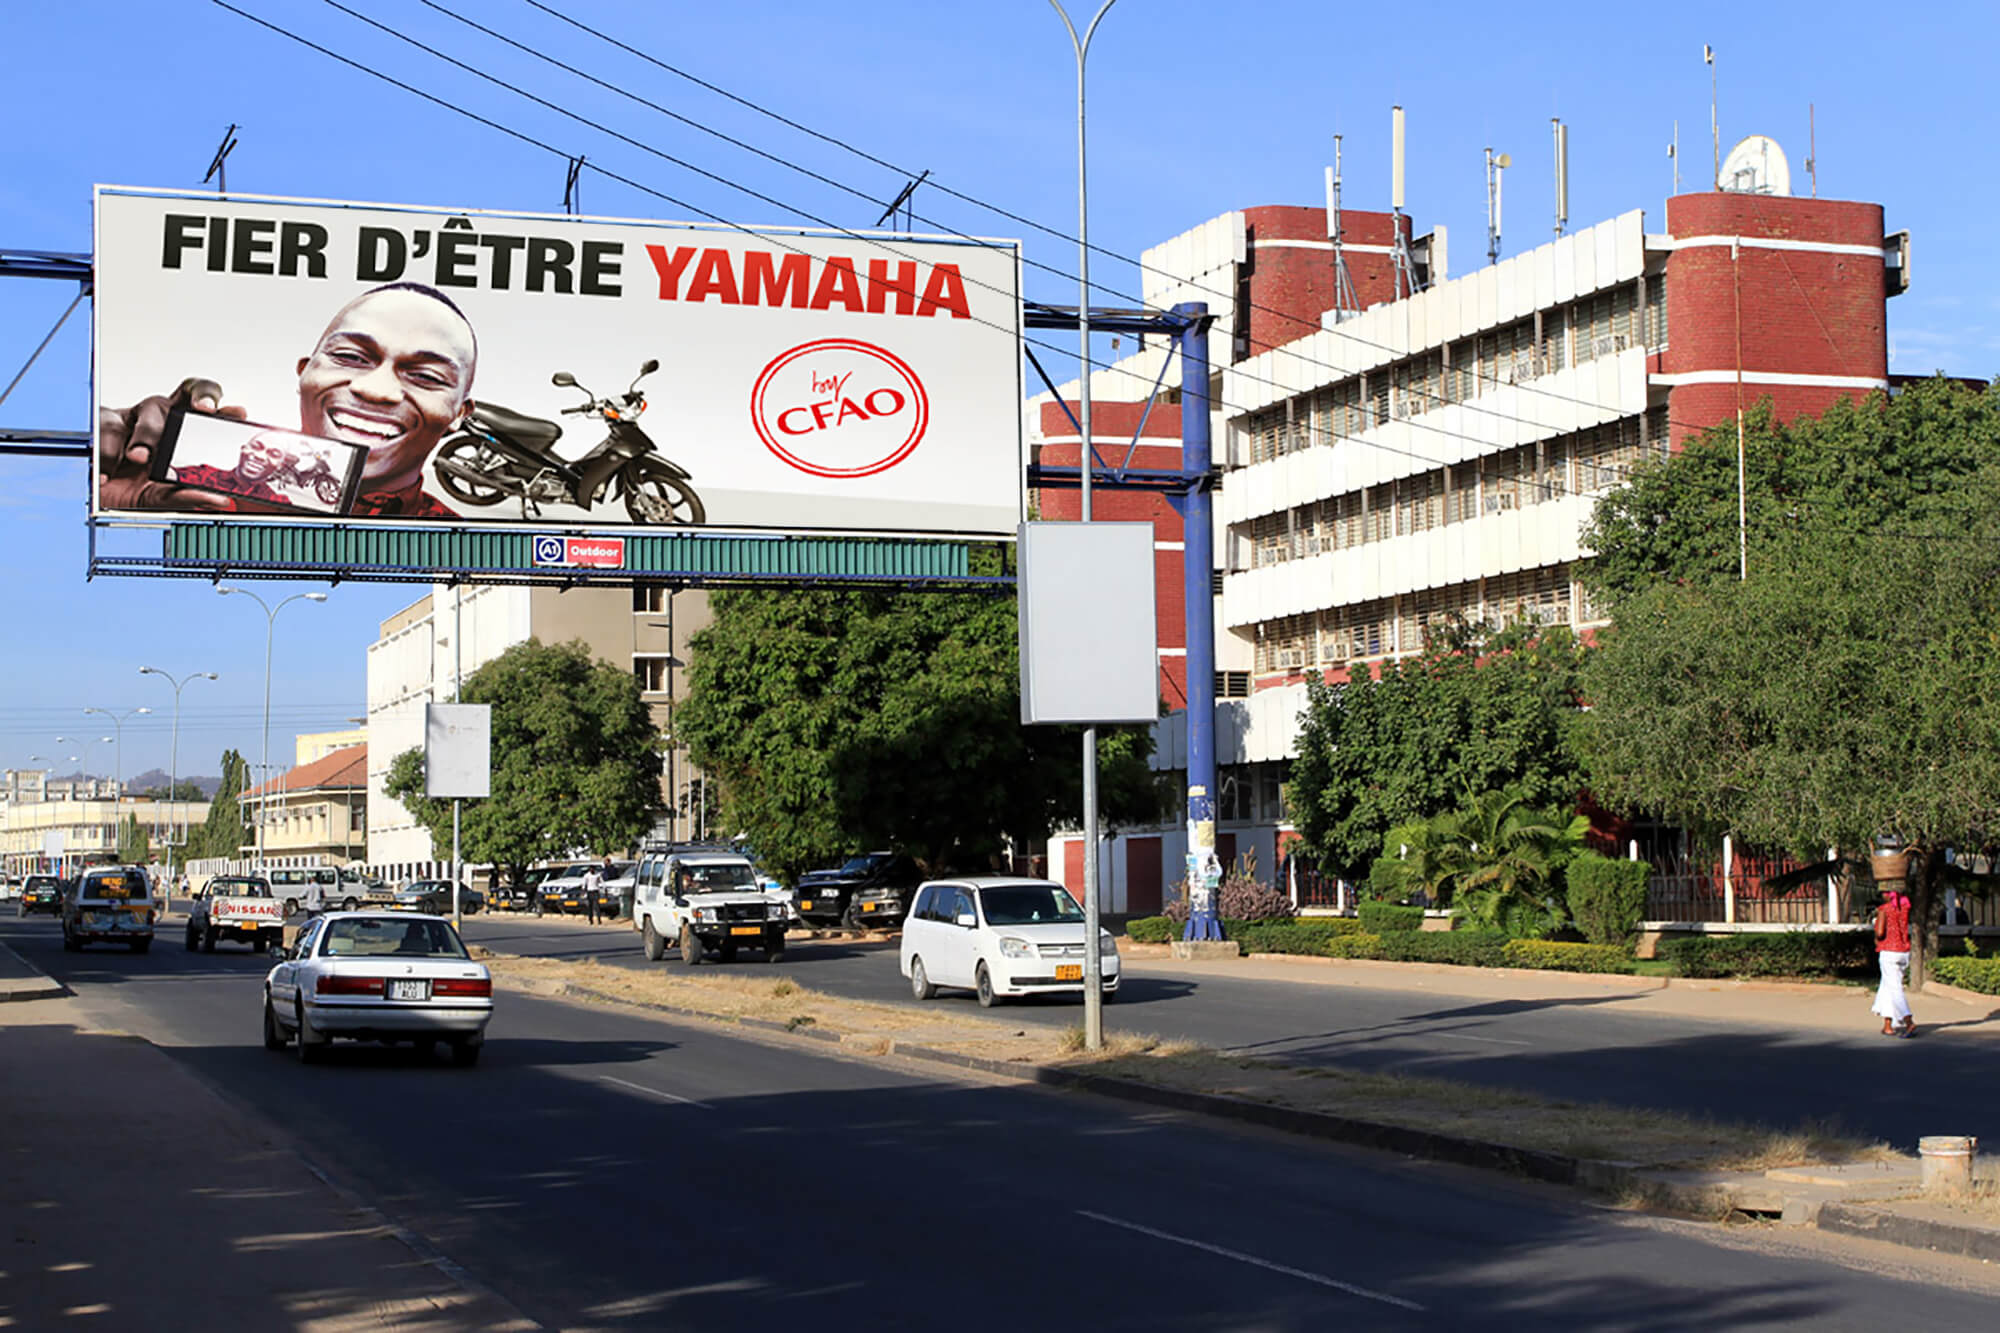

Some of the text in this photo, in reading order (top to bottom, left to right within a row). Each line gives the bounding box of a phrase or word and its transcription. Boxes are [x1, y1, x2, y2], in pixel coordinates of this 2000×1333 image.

[161, 213, 328, 279] FIER
[645, 243, 971, 320] YAMAHA
[811, 369, 854, 402] by
[776, 387, 906, 436] CFAO
[570, 545, 619, 557] Outdoor
[227, 904, 275, 915] NISSAN
